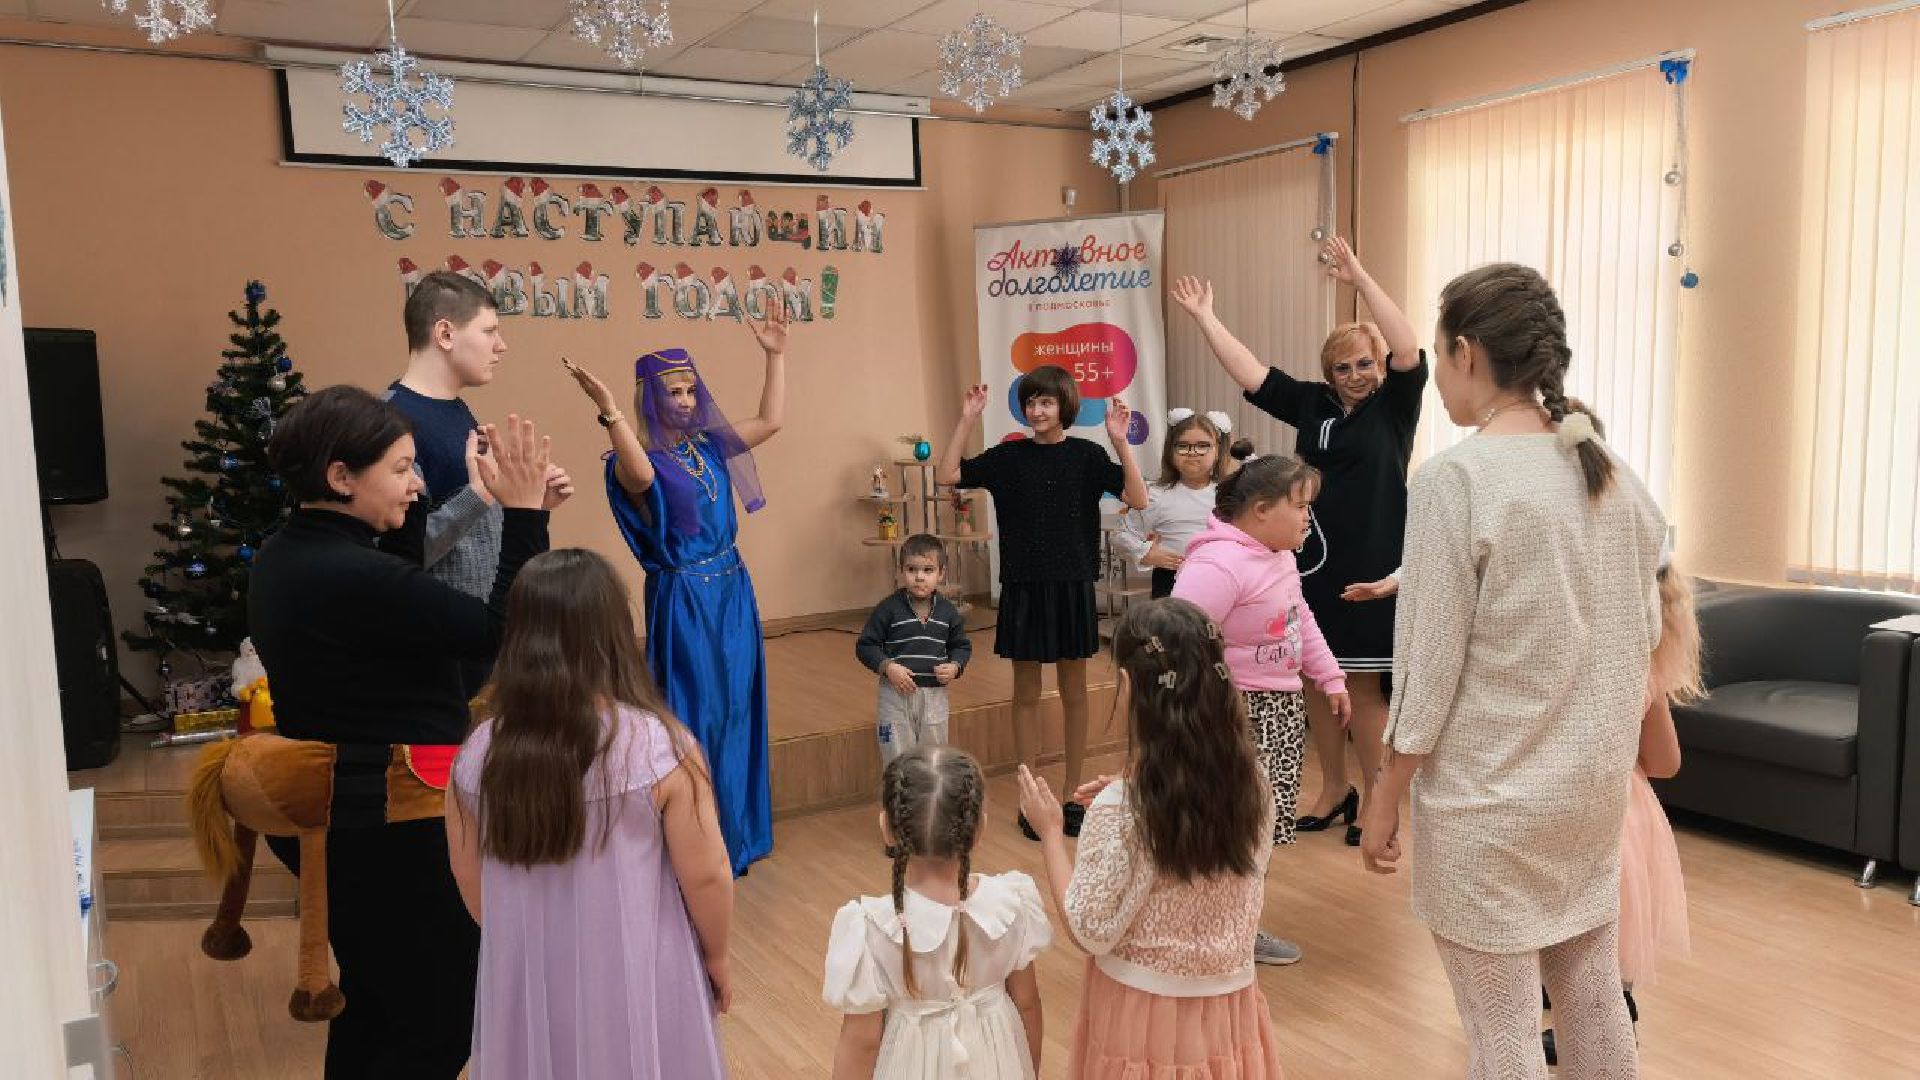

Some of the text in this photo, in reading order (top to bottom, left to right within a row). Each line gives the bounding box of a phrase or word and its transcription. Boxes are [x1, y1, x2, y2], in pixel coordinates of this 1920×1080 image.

[371, 188, 415, 240] С
[987, 234, 1147, 272] Актвное
[403, 263, 610, 320] ВЫМ
[1034, 341, 1114, 357] женщины
[1074, 362, 1114, 382] 55+
